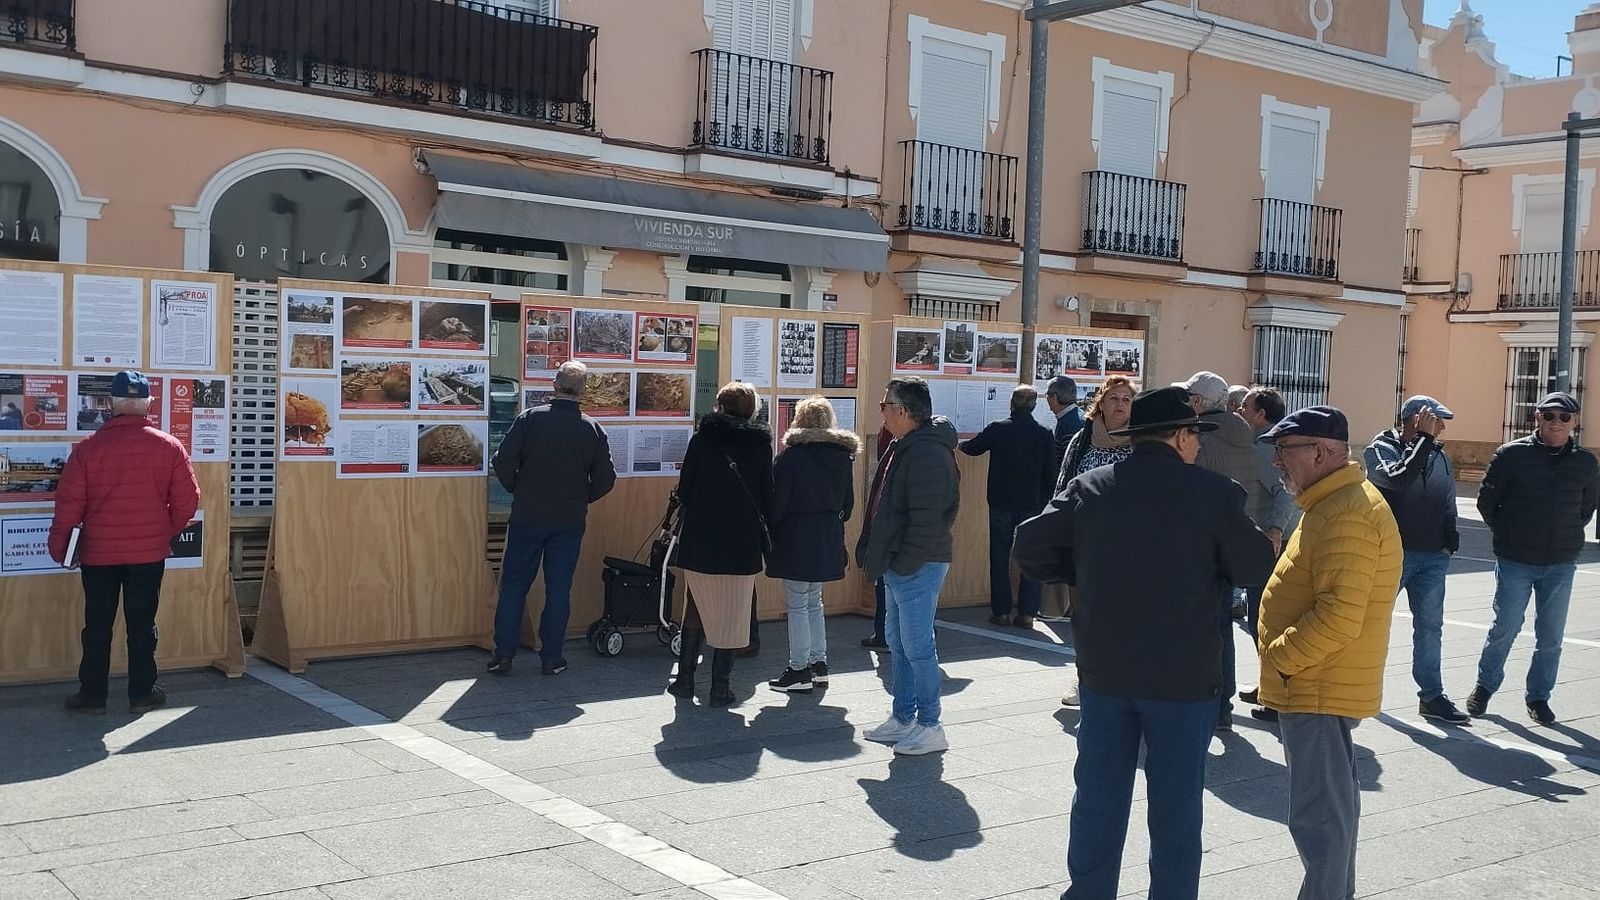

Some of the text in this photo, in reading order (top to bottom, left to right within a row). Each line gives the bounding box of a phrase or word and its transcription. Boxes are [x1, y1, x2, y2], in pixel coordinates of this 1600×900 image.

[634, 218, 733, 240] VIVIENDA SUR
[236, 241, 367, 269] ÓPTICAS
[185, 290, 208, 299] PROA
[178, 532, 195, 542] AIT
